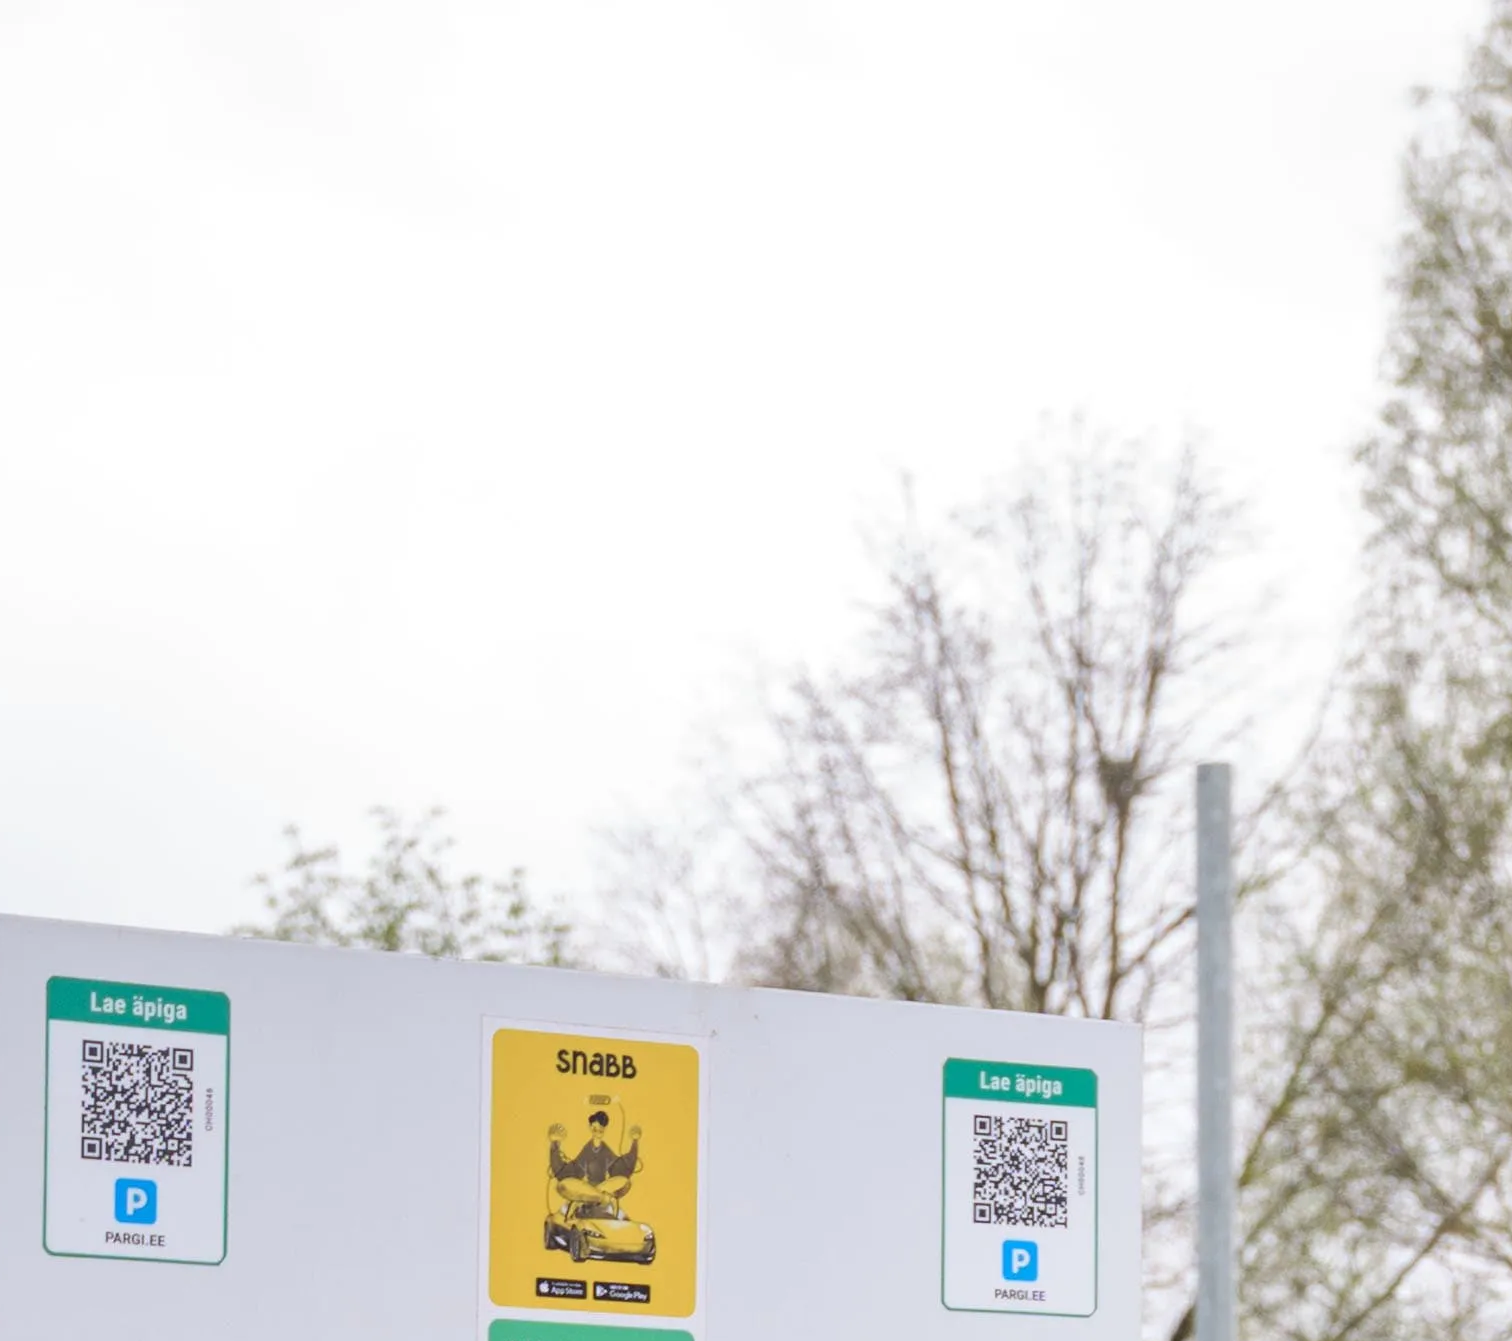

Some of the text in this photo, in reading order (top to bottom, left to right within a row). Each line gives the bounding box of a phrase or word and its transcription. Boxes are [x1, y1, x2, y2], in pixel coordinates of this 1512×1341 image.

[90, 991, 187, 1024] Lae äpiga
[980, 1070, 1063, 1098] Lae äpiga
[126, 1186, 148, 1216] P
[105, 1231, 166, 1247] PARGI.EE
[1011, 1248, 1031, 1274] P
[551, 1286, 584, 1296] App Store
[609, 1290, 648, 1301] Google Play
[994, 1289, 1046, 1302] PARGI.EE
